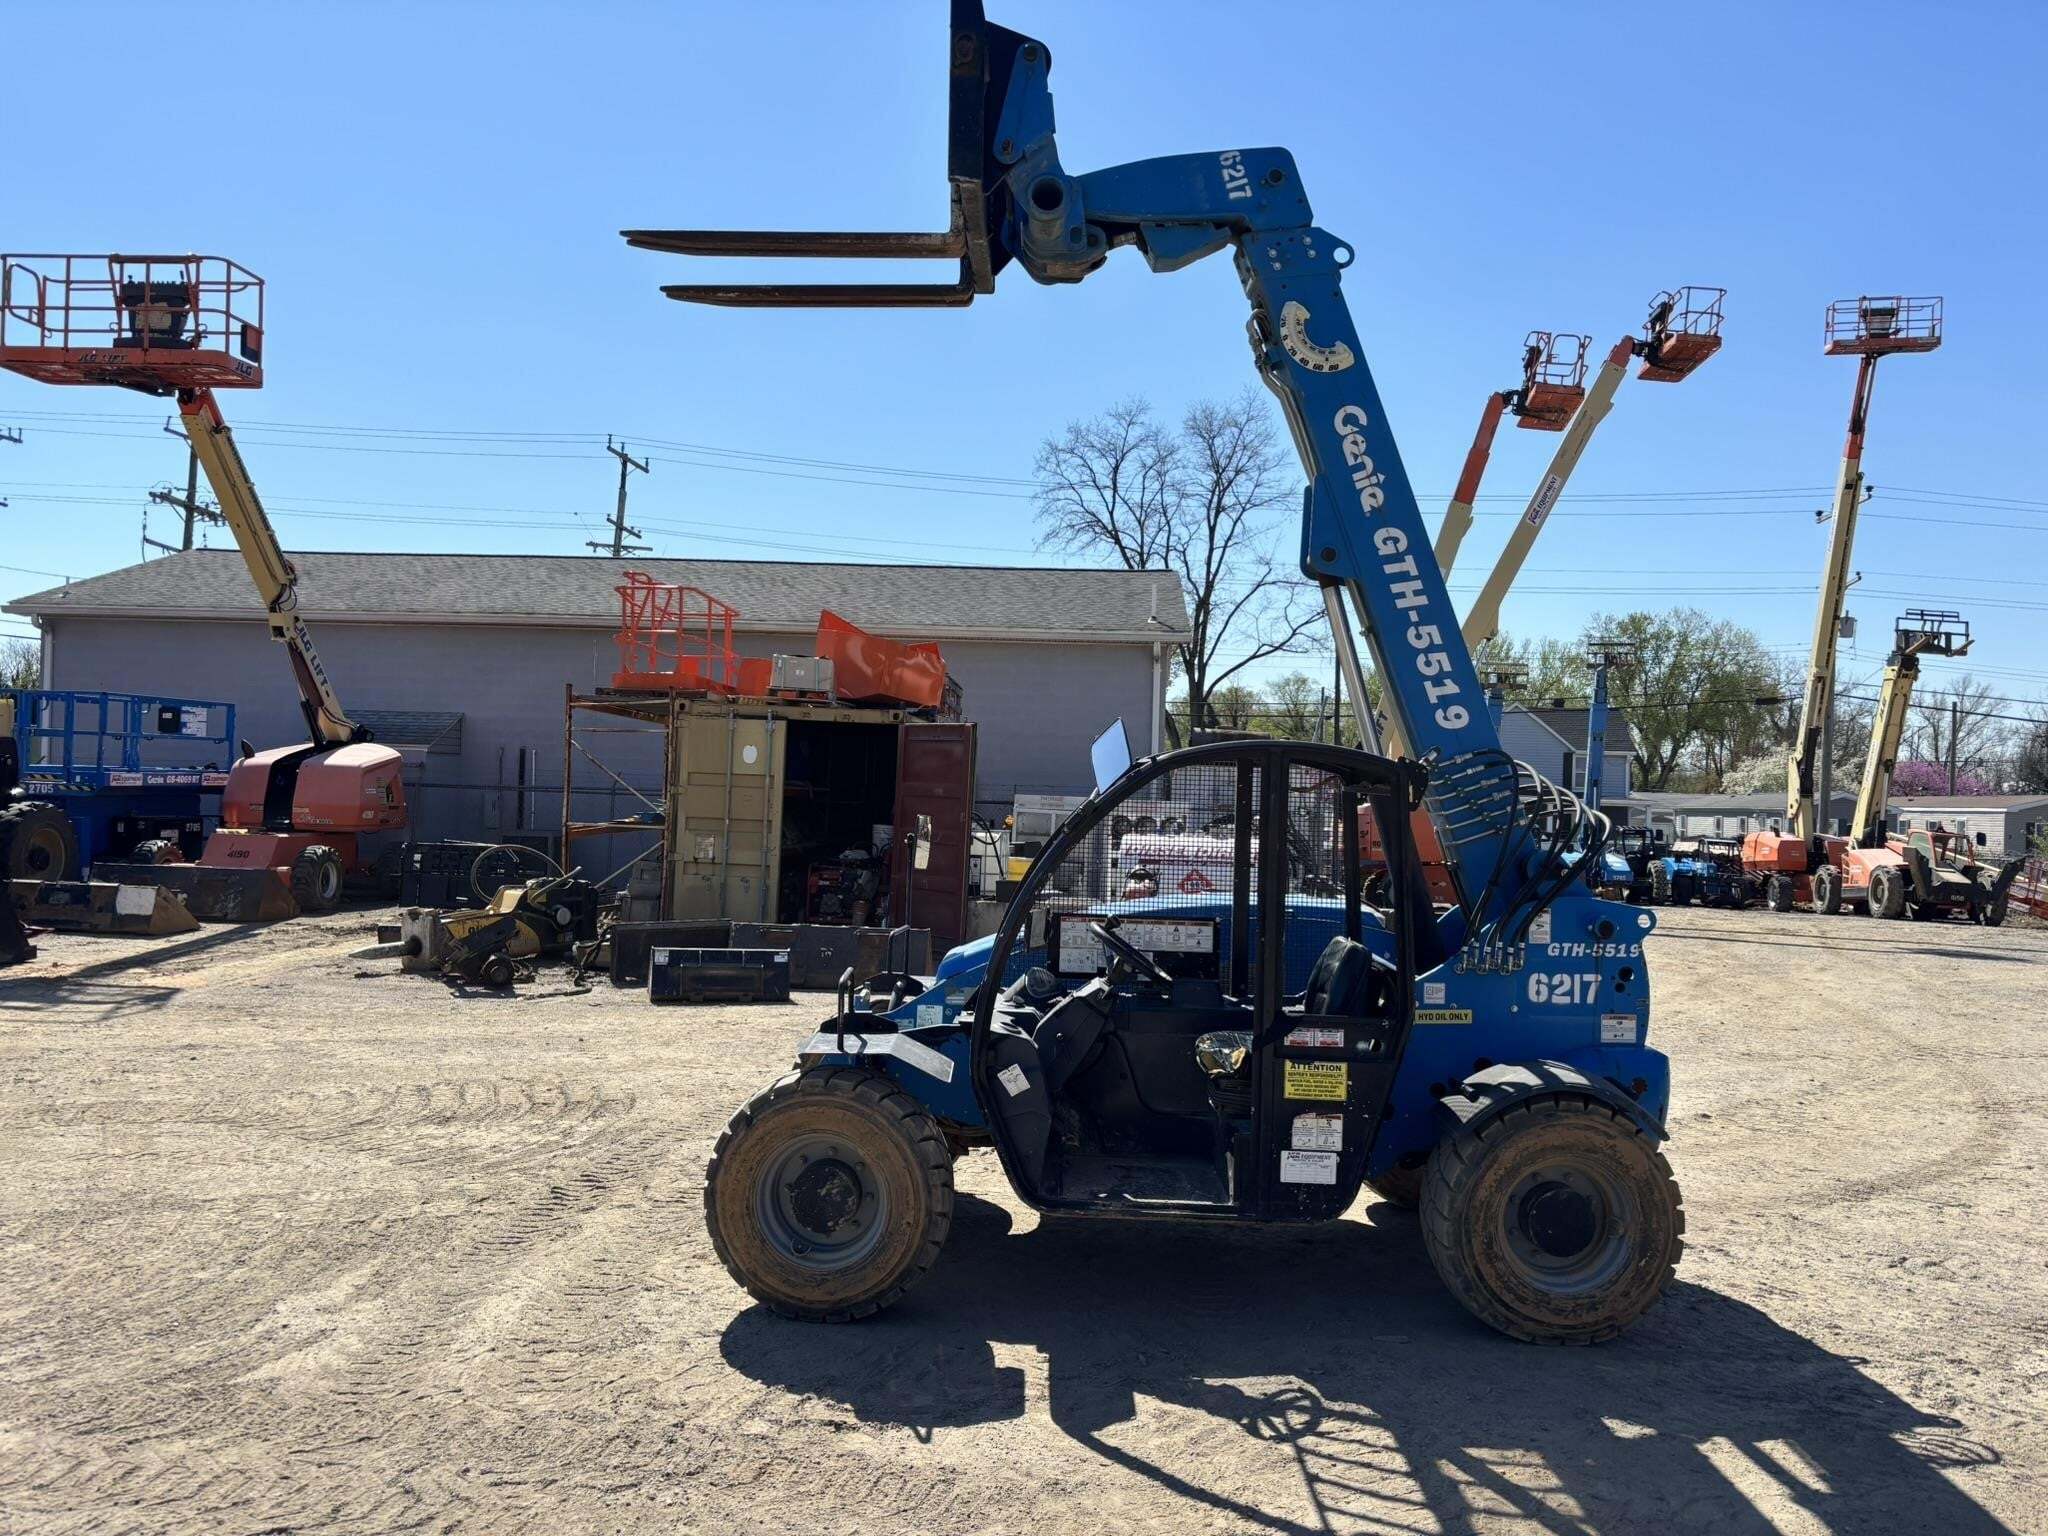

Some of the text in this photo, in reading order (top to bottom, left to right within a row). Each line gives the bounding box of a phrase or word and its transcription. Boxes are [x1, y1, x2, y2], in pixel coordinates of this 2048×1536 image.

[1219, 151, 1252, 199] 6217
[235, 361, 253, 376] JLG
[1333, 405, 1470, 730] Genie GTH-5519
[294, 625, 329, 686] JLG LIFT
[147, 775, 164, 784] Genie
[28, 784, 54, 794] 2705
[1547, 943, 1640, 958] GTH-5519
[1528, 972, 1602, 1005] 6217
[1418, 1012, 1469, 1021] HYD OIL ONLY
[1289, 1062, 1342, 1072] ATTENTION
